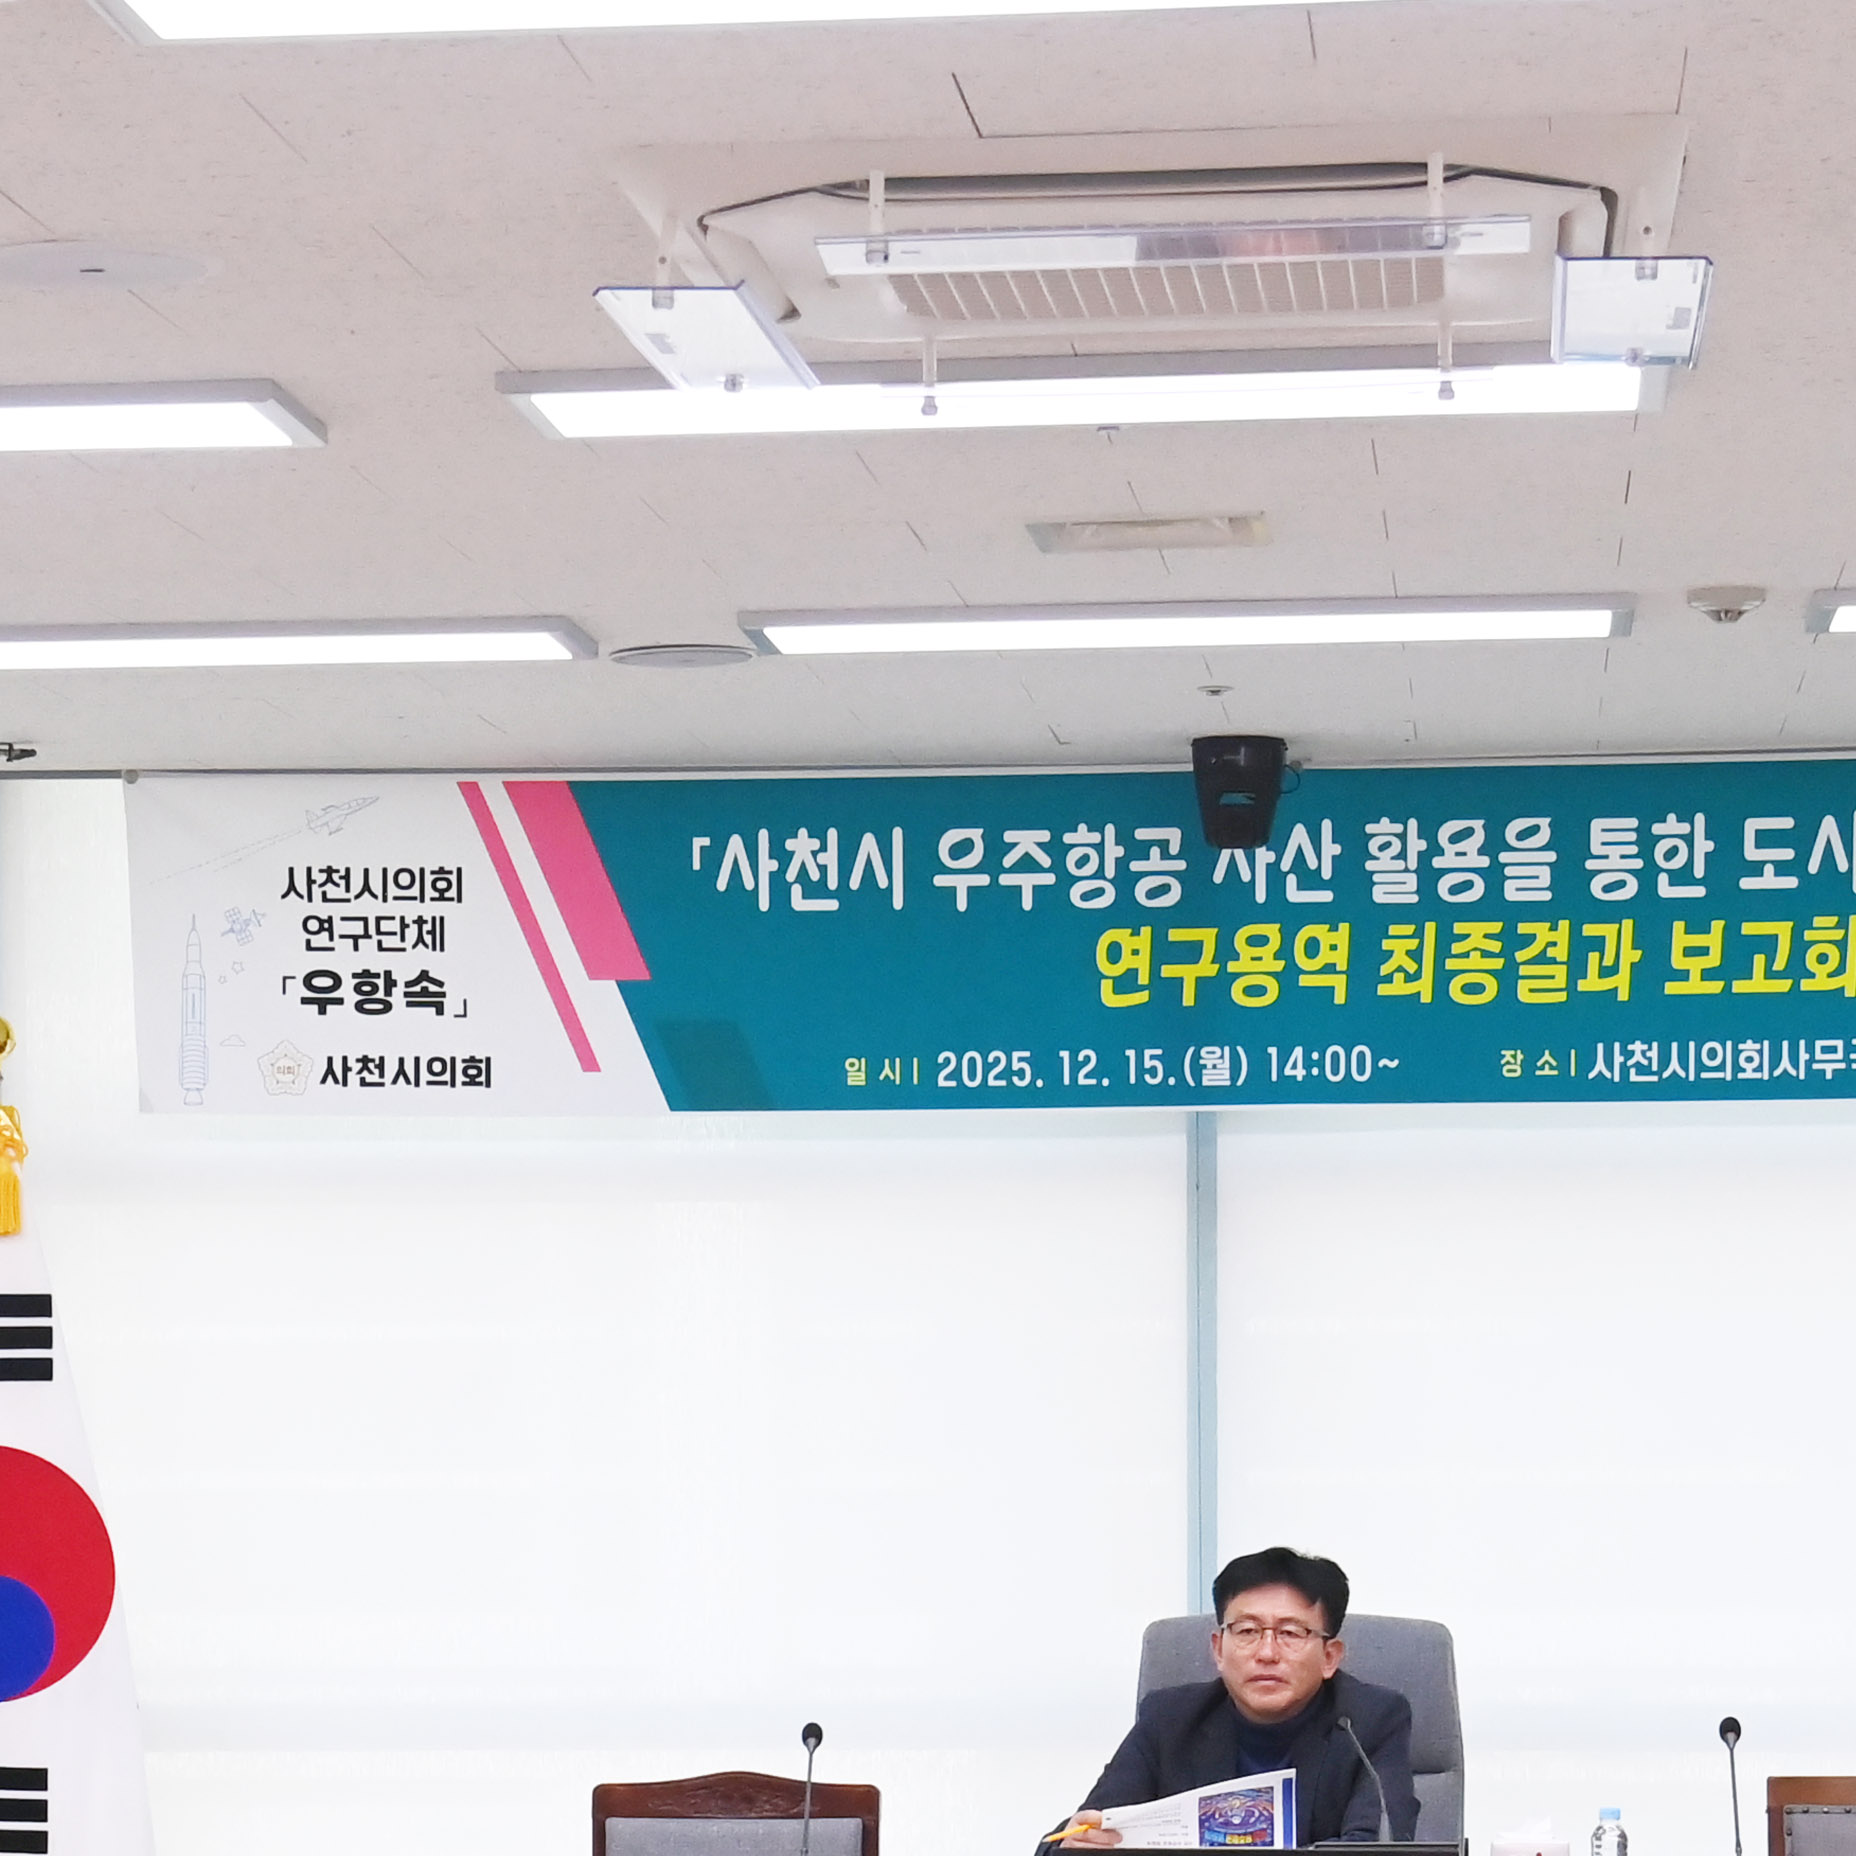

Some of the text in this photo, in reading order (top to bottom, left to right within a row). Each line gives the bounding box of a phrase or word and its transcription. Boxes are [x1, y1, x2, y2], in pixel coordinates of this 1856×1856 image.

[280, 865, 463, 904] 사천시의회
[692, 826, 904, 912] 「사천시
[932, 822, 1187, 913] 우주항공
[1364, 816, 1558, 904] 활용을
[1584, 812, 1715, 901] 통한
[302, 915, 445, 953] 연구단체
[1096, 922, 1350, 1008] 연구용역
[1378, 918, 1643, 1005] 최종결과
[282, 968, 467, 1018] 「우항속」
[319, 1054, 492, 1089] 사천시의회
[937, 1050, 1044, 1088] 2025.
[1058, 1048, 1110, 1087] 12.
[1267, 1044, 1400, 1083] 14:00~
